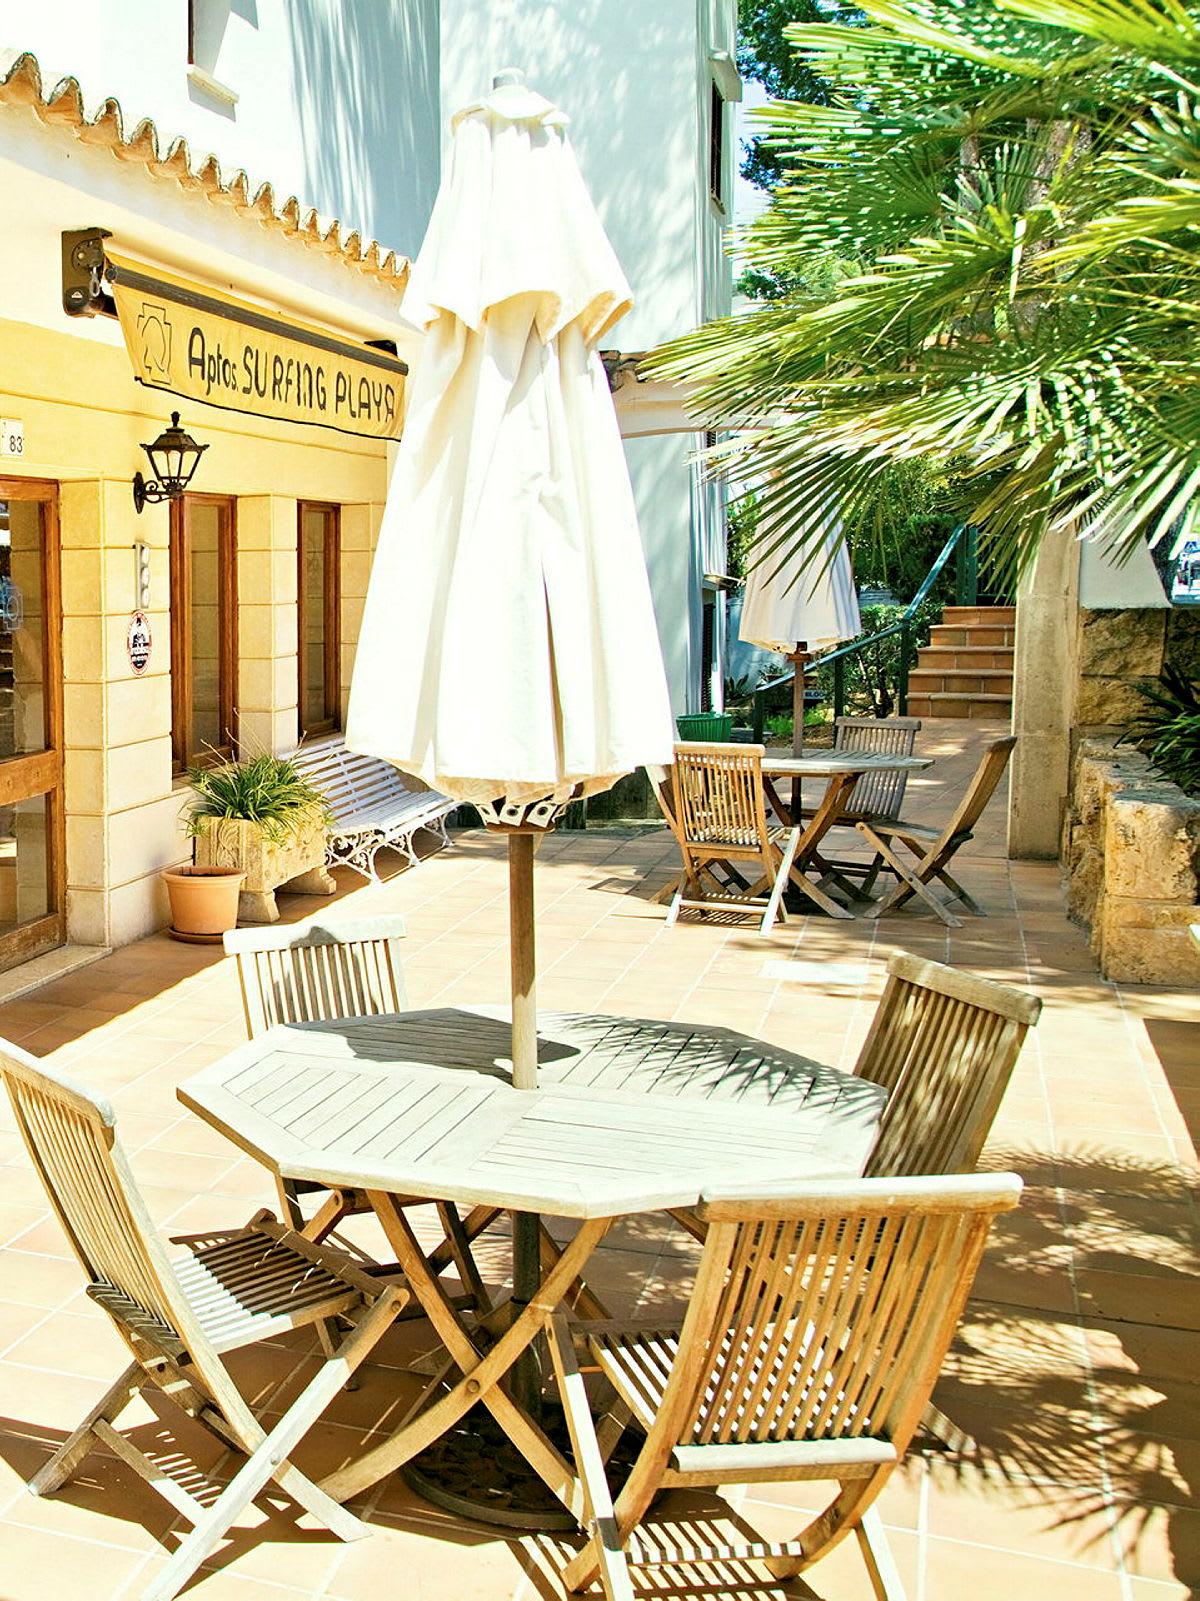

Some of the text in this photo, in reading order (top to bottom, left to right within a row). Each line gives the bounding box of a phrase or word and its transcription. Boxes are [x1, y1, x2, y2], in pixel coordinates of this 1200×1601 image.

[242, 345, 327, 411] SURFING
[335, 371, 395, 423] PLAYA
[9, 435, 23, 453] 83
